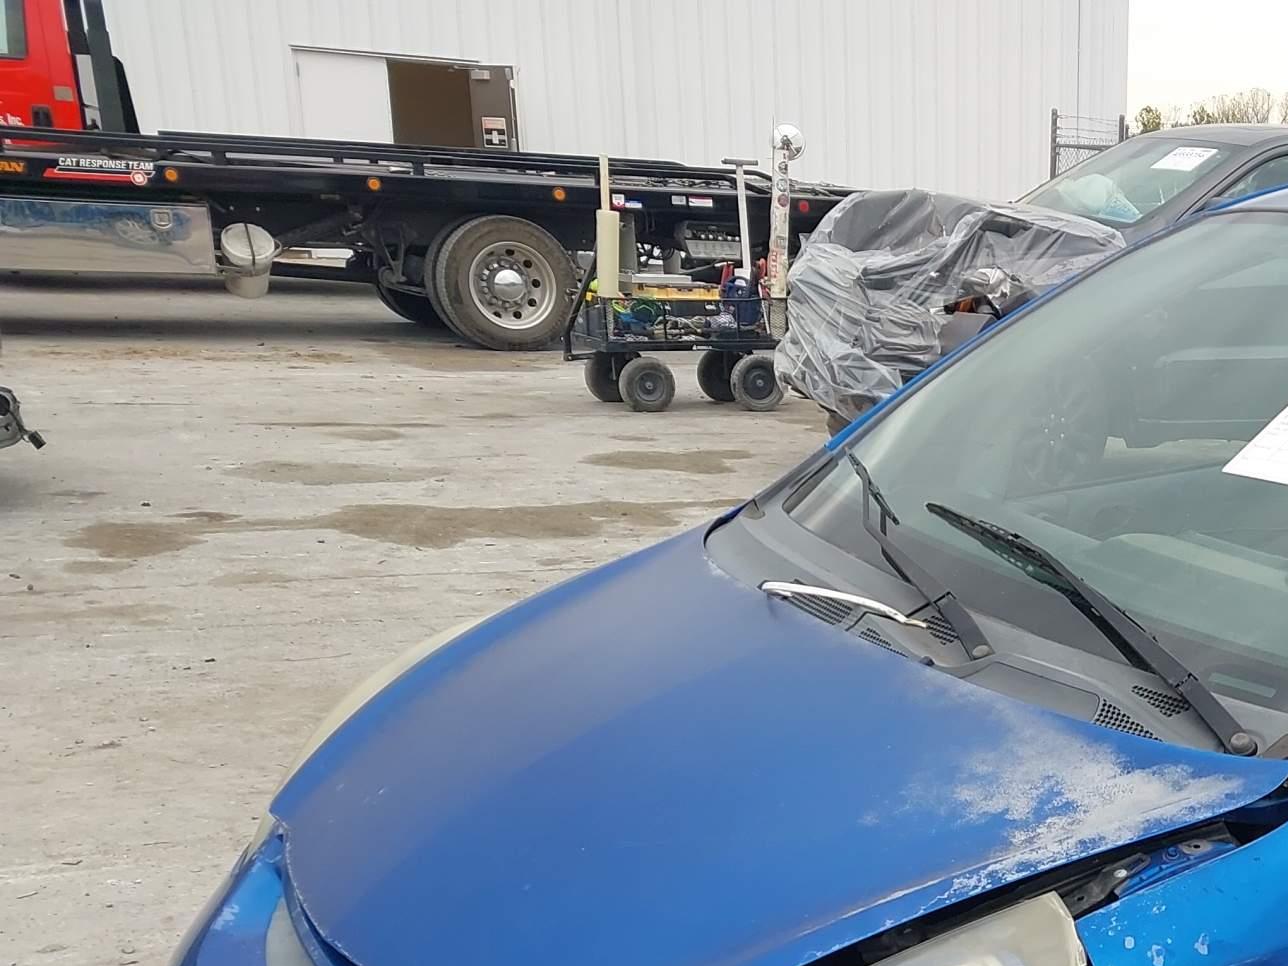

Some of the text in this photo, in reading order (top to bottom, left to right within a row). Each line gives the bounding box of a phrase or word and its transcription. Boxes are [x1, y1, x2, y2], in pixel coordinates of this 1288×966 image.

[58, 157, 154, 171] CAT RESPONSE TEAM
